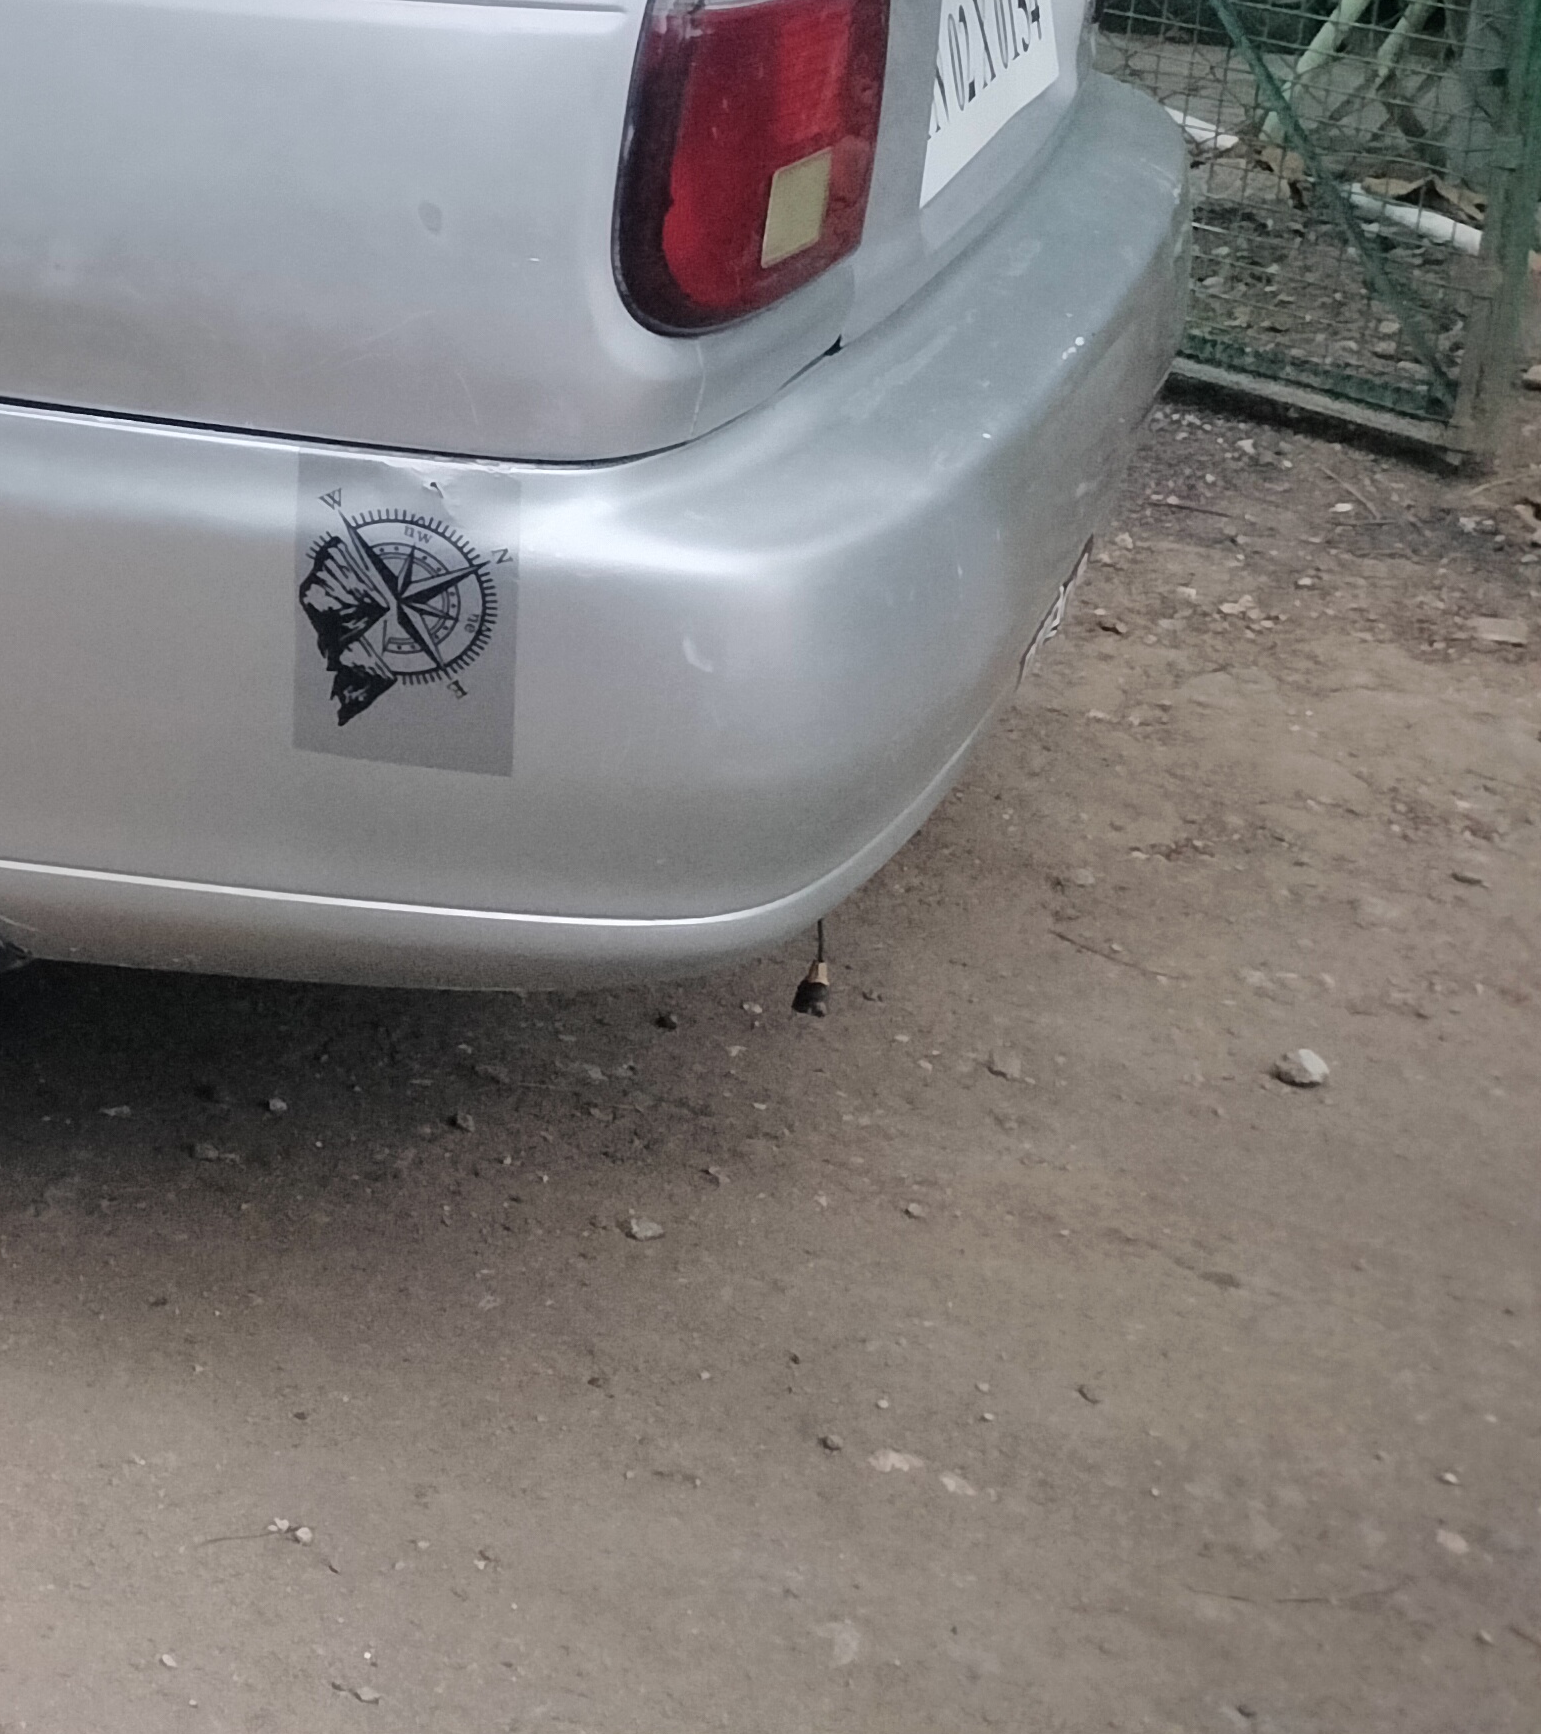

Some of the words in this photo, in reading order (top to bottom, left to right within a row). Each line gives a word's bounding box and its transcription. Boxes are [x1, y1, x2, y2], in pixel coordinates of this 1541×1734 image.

[947, 3, 977, 112] 02
[318, 487, 344, 512] W
[490, 547, 514, 566] N
[446, 679, 468, 700] E
